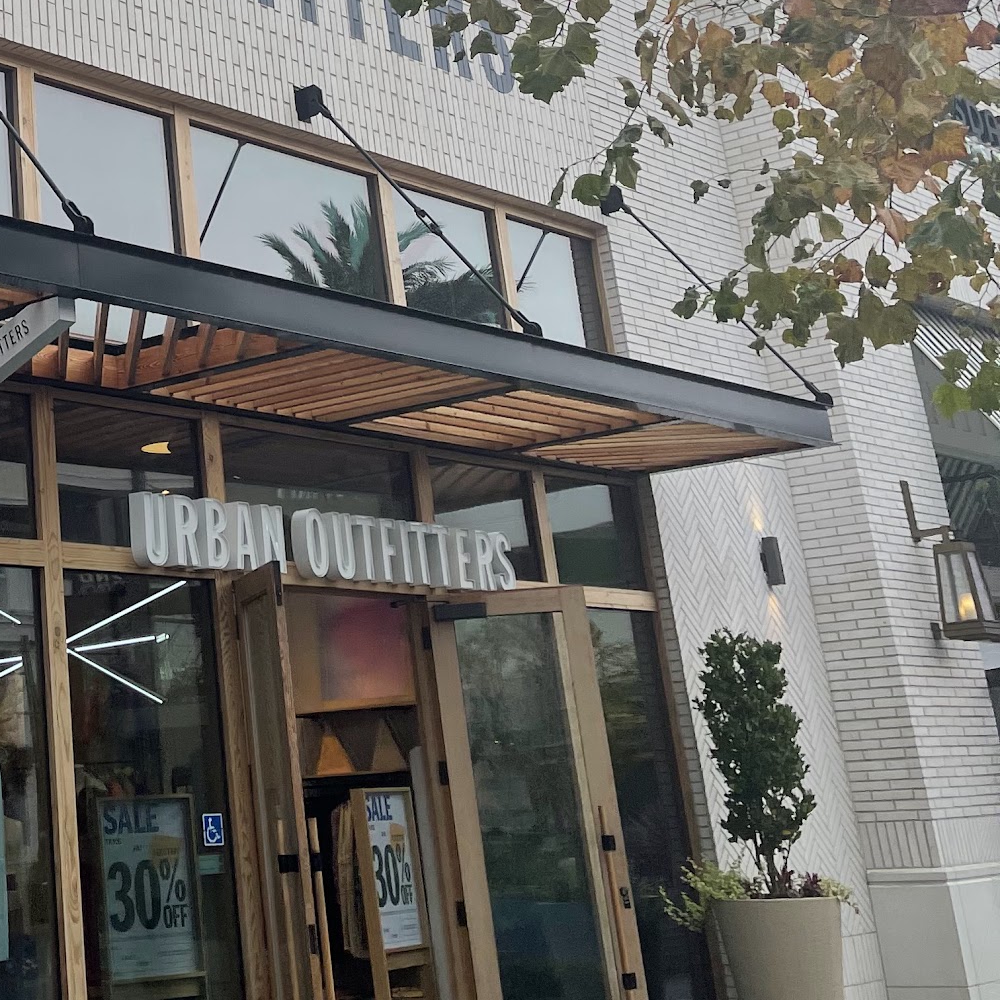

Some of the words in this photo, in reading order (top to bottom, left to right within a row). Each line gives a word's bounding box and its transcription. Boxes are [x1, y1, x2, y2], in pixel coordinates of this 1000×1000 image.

[129, 491, 287, 574] URBAN
[291, 507, 517, 591] OUTFITTERS
[103, 801, 160, 836] SALE
[107, 857, 187, 933] 30%
[163, 904, 189, 929] OFF
